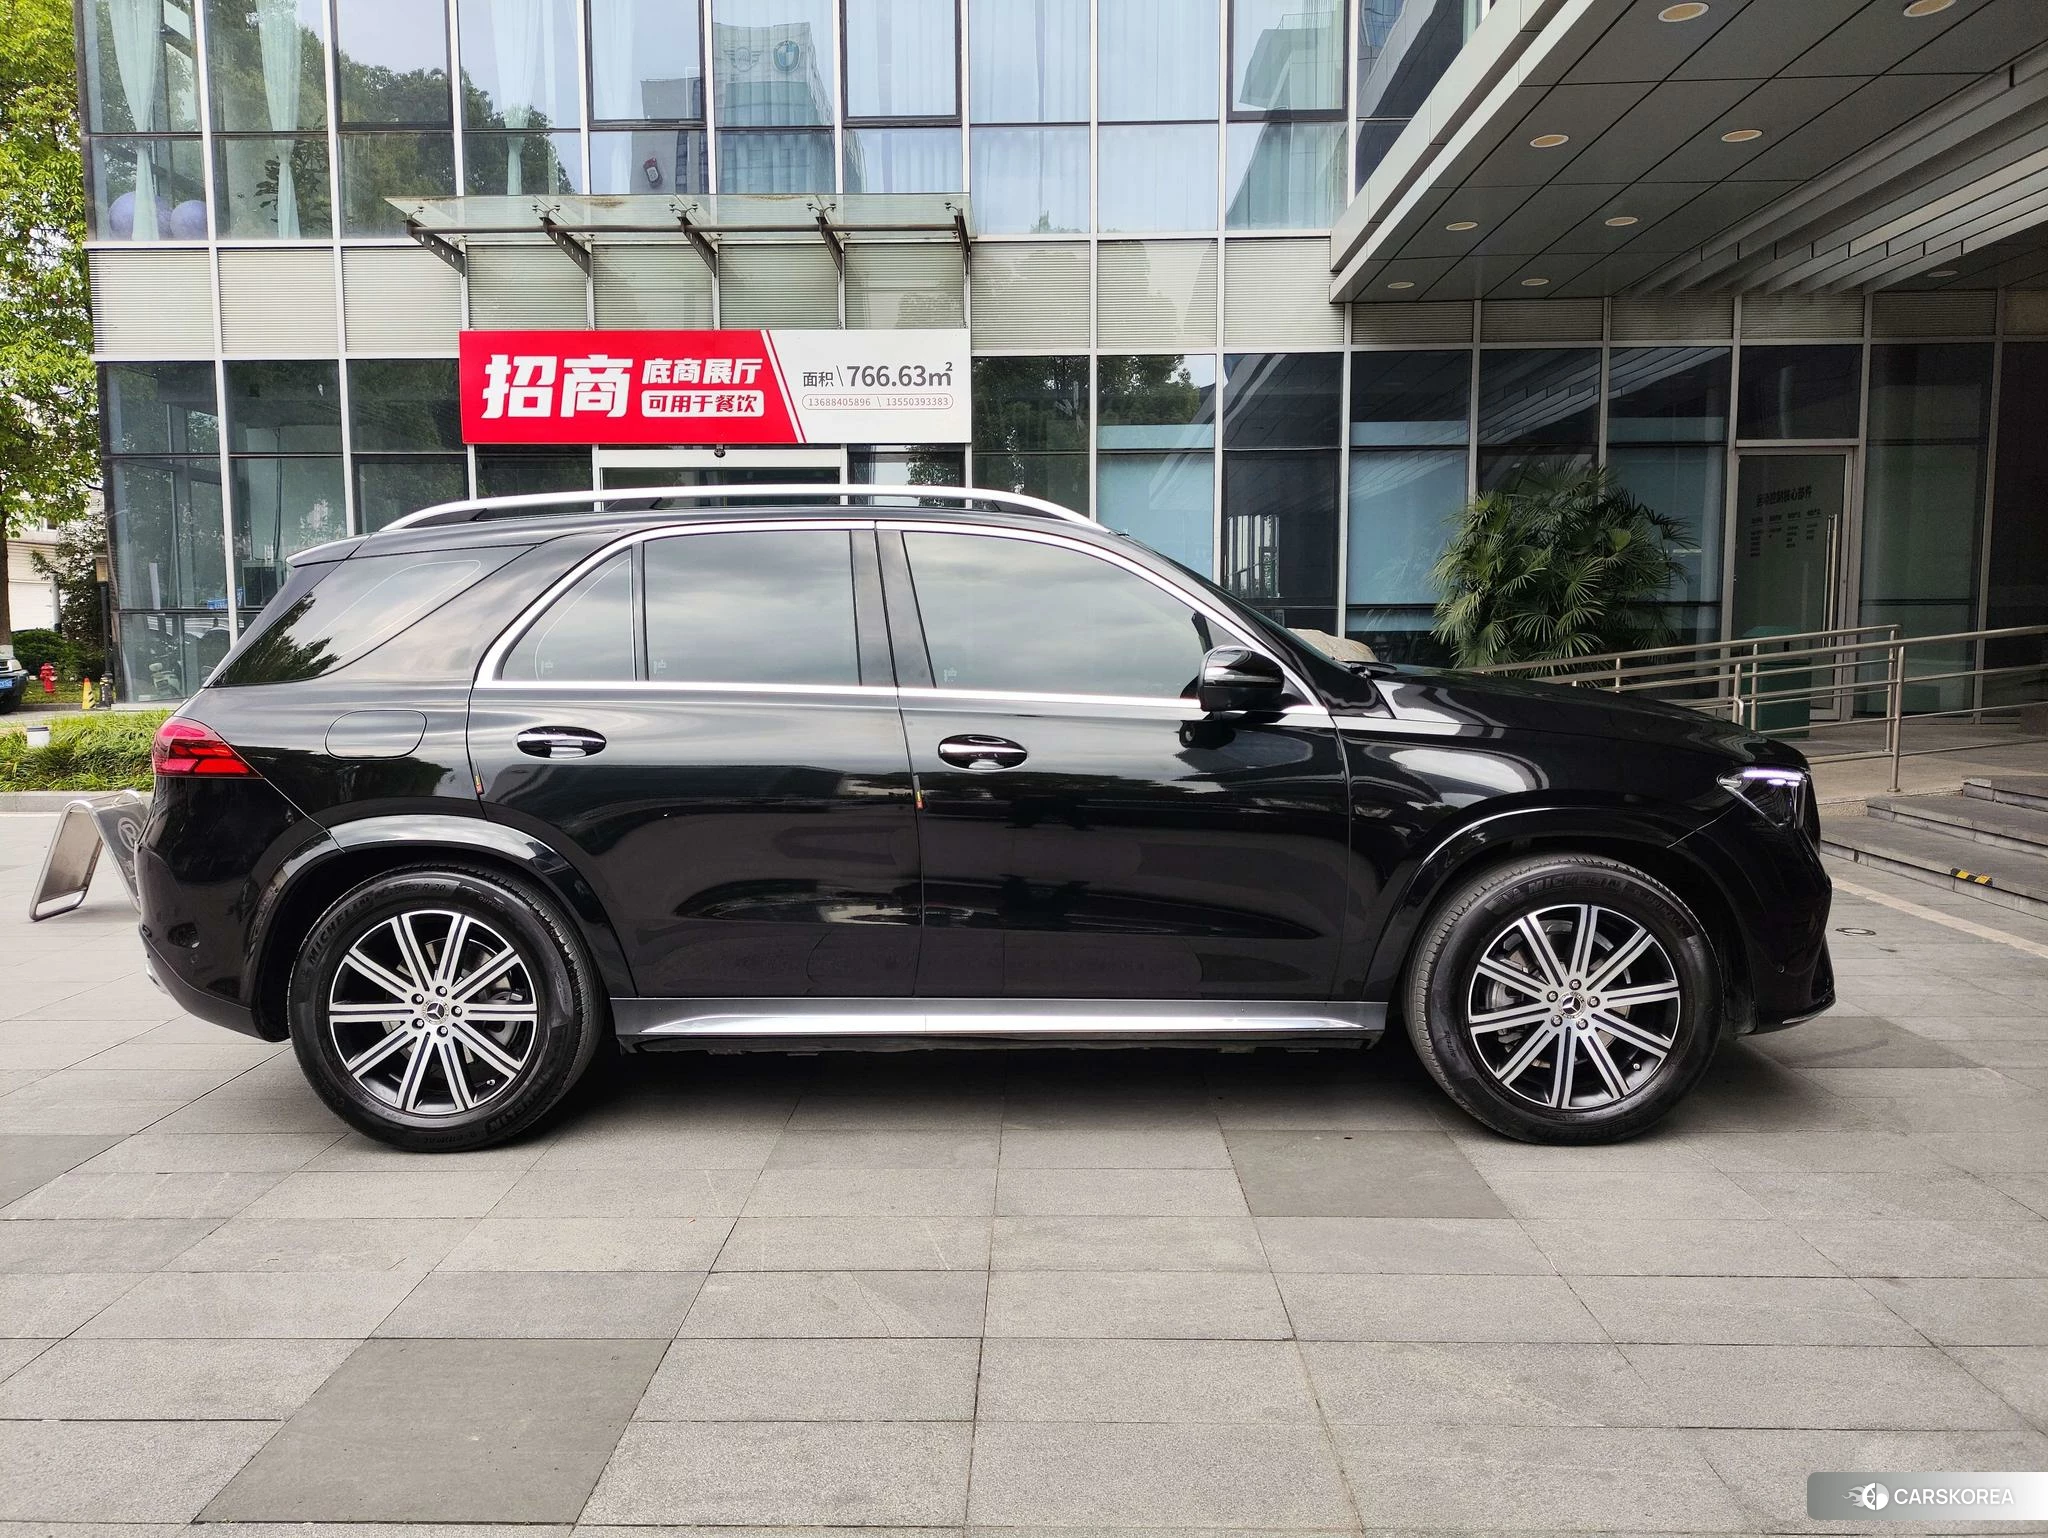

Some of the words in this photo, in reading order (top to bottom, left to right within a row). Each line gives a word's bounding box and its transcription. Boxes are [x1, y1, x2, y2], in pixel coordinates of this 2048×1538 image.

[641, 357, 764, 384] 底商展厅
[802, 371, 834, 387] 面积
[481, 354, 633, 418] 招商
[648, 394, 758, 413] 可用于餐饮
[808, 398, 871, 407] 13688405896
[886, 397, 949, 406] 13550393383
